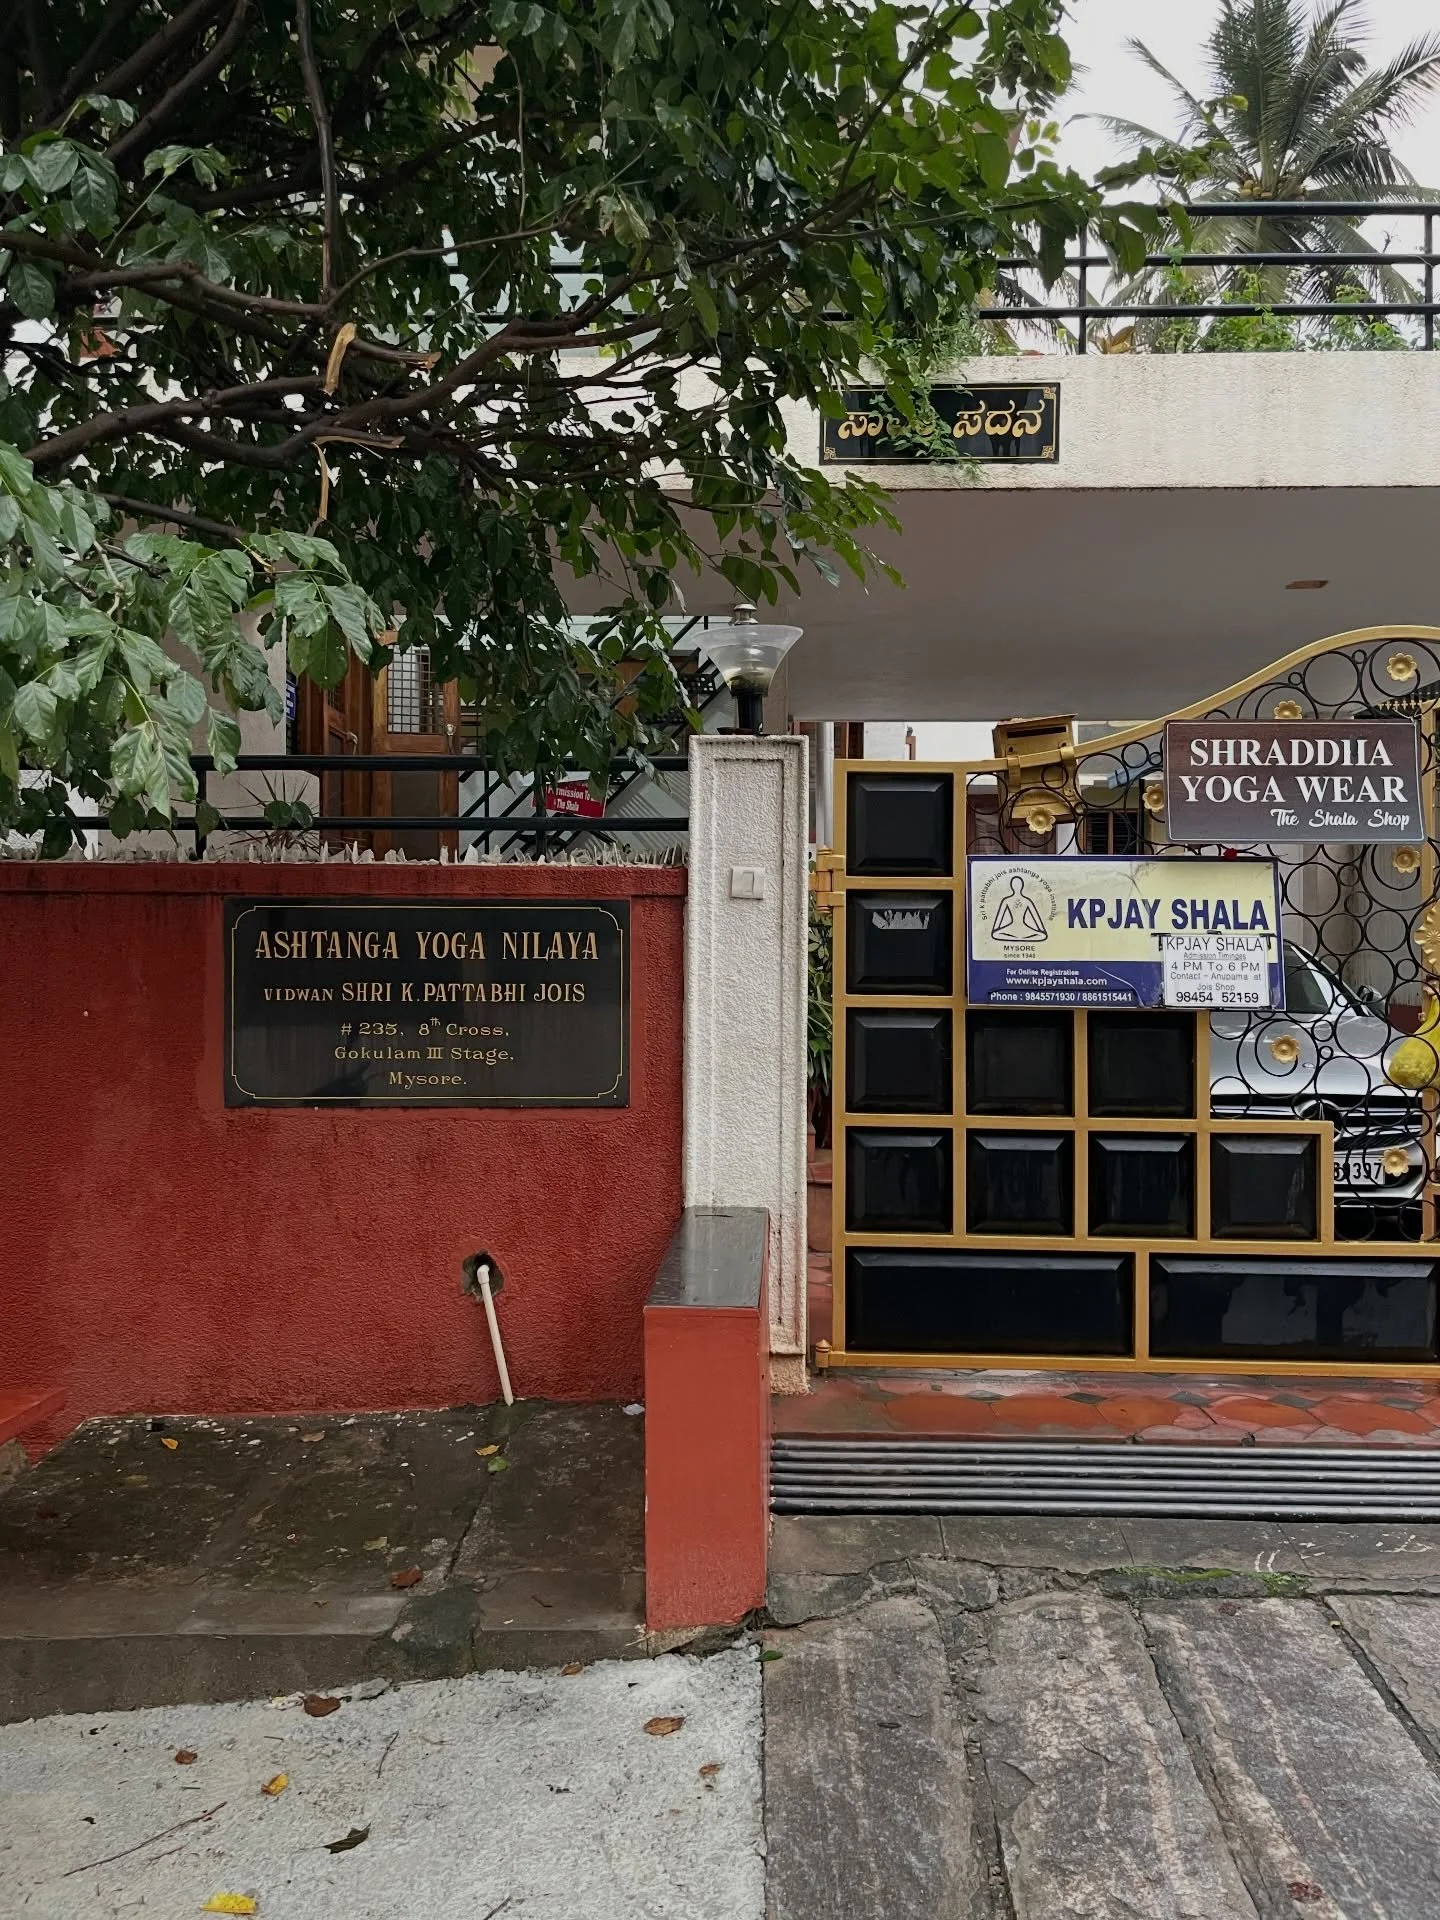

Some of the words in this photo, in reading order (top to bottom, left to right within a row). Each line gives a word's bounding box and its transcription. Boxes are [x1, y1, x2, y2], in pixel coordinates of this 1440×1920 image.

[953, 399, 1045, 438] ಸದನ
[547, 786, 584, 799] Prmission
[1179, 775, 1286, 803] YOGA
[1295, 775, 1408, 803] WEAR
[1270, 808, 1299, 827] The
[1308, 809, 1358, 828] Shala
[1367, 809, 1410, 830] Shop
[980, 878, 996, 904] pattabhi
[994, 870, 1008, 881] jois
[1039, 878, 1053, 893] yoga
[1067, 899, 1161, 928] KPJAY
[1171, 899, 1269, 930] SHALA
[255, 931, 400, 960] ASHTANGA
[416, 931, 487, 960] YOGA
[502, 931, 600, 962] NILAYA
[1167, 937, 1211, 950] KPJAY
[1216, 937, 1264, 951] SHALA
[1040, 968, 1080, 976] Registration
[1171, 962, 1178, 970] 4
[1183, 962, 1202, 971] PM
[1208, 962, 1223, 971] To
[1228, 962, 1236, 971] 6
[1241, 962, 1260, 971] PM
[1006, 977, 1107, 986] www.kpjayshala.com
[1170, 972, 1201, 980] Contact
[1211, 973, 1248, 981] Anupama
[263, 988, 334, 1001] VIDWAN
[342, 982, 392, 1002] SHRI
[534, 983, 585, 1002] JOIS
[990, 992, 1018, 1001] Phone
[1025, 992, 1075, 1001] 9845571930
[1082, 992, 1132, 1002] 8861515441
[1176, 992, 1214, 1002] 98454
[1197, 983, 1213, 991] Jois
[1215, 983, 1236, 992] Shop
[418, 1016, 441, 1036] 8th
[335, 1046, 421, 1060] Gokulam
[426, 1046, 445, 1060] III
[451, 1046, 514, 1065] Stage,
[389, 1071, 467, 1090] Mysore.
